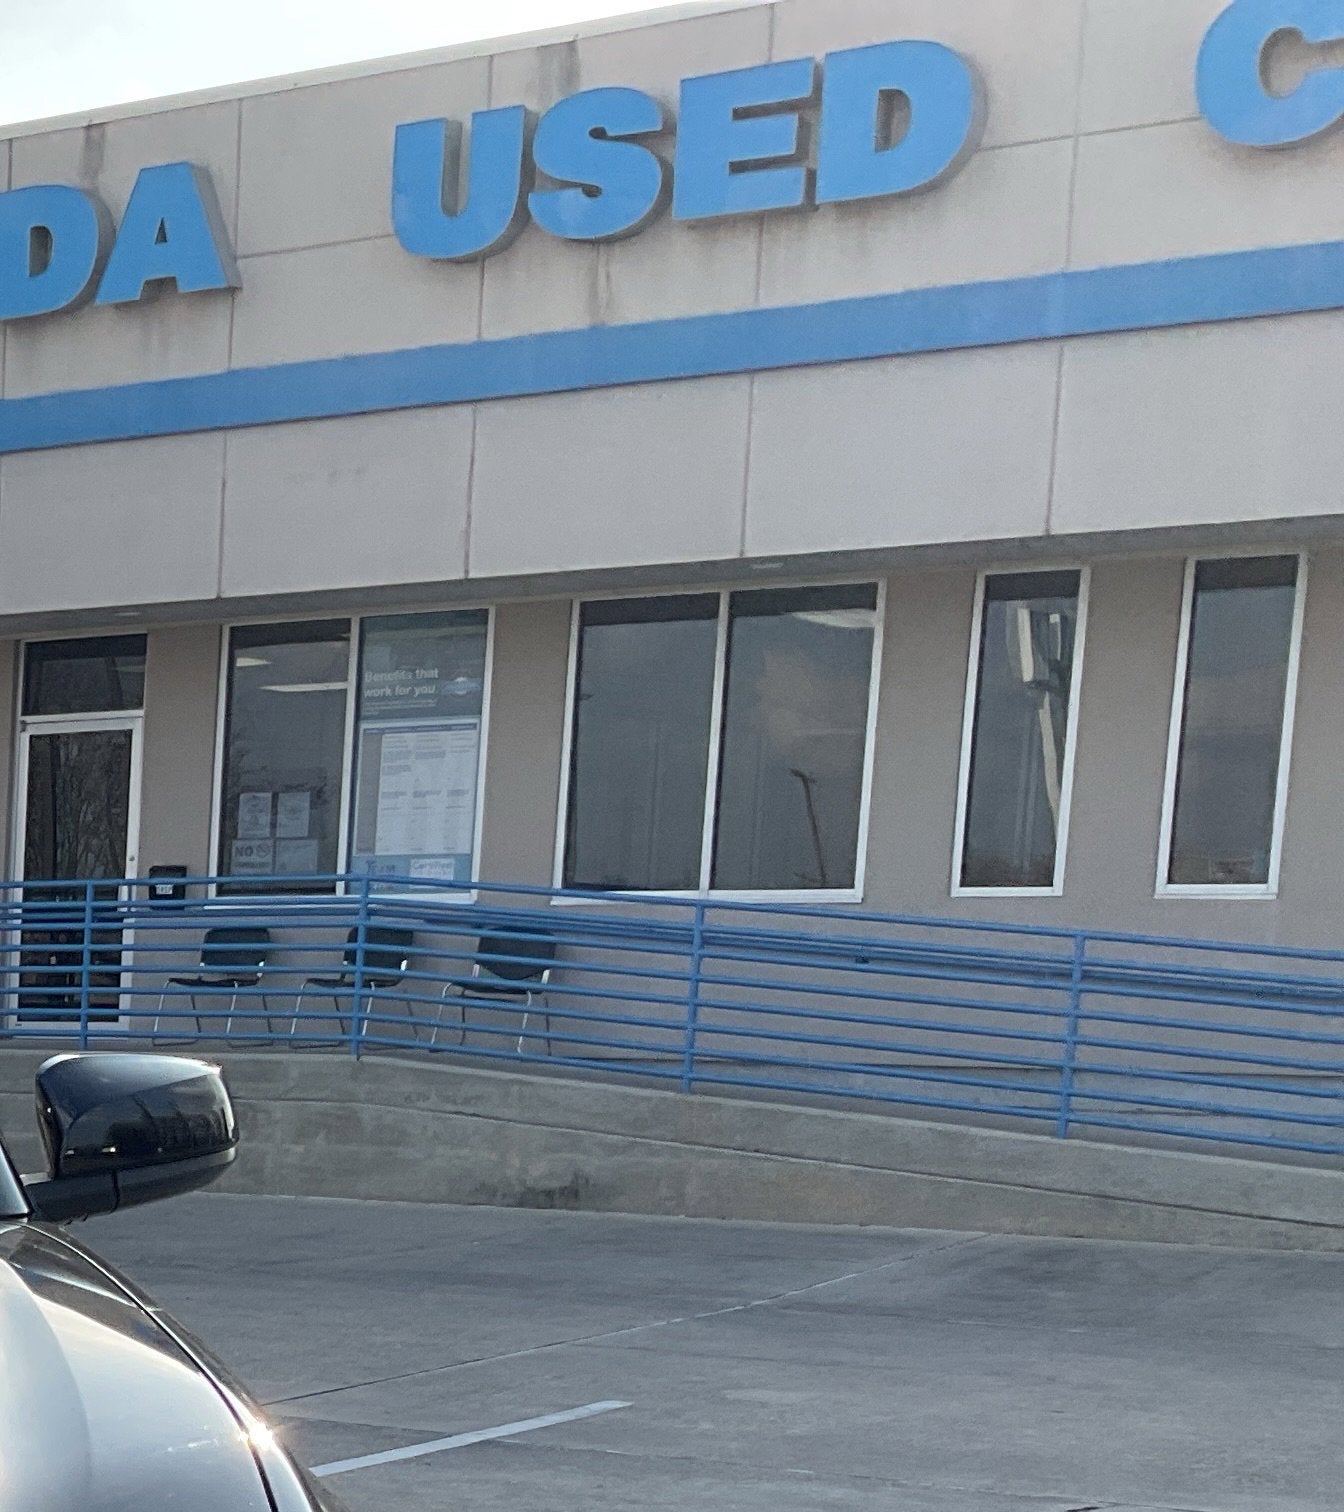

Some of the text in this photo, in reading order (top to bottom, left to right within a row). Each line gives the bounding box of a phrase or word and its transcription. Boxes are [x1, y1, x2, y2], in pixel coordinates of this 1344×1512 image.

[391, 40, 980, 260] USED
[364, 667, 439, 682] Benefits that
[364, 686, 392, 698] work
[395, 686, 412, 696] for
[235, 845, 254, 857] NO
